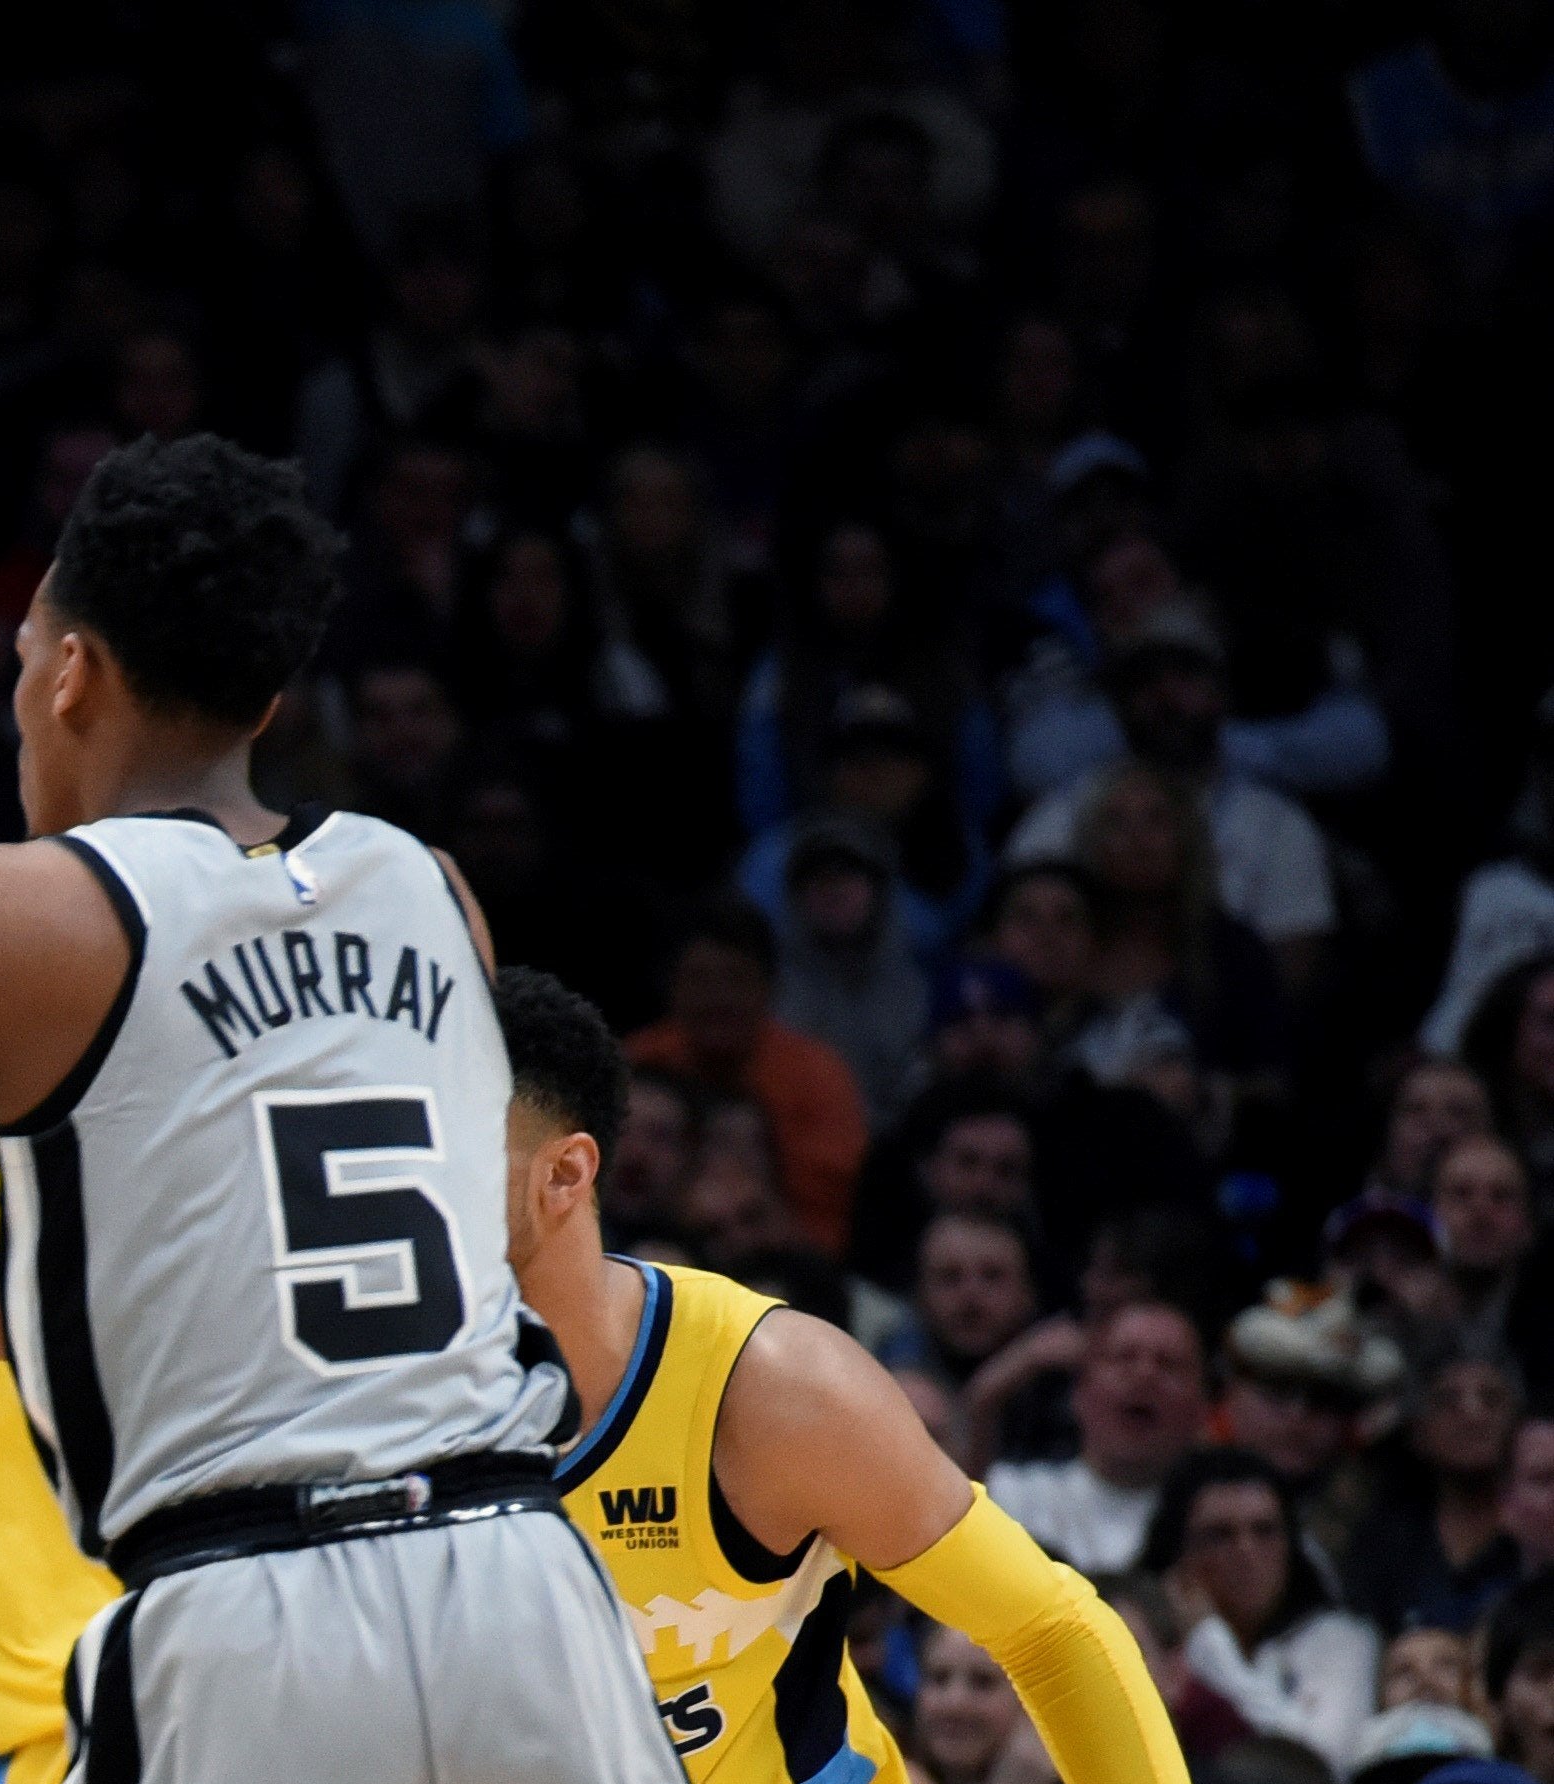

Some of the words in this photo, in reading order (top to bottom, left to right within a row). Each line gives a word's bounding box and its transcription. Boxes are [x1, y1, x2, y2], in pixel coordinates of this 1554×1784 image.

[181, 931, 455, 1058] MURRAY
[252, 1085, 475, 1378] 5
[598, 1486, 677, 1526] WU
[600, 1526, 678, 1540] WESTERN
[625, 1538, 679, 1550] UNION
